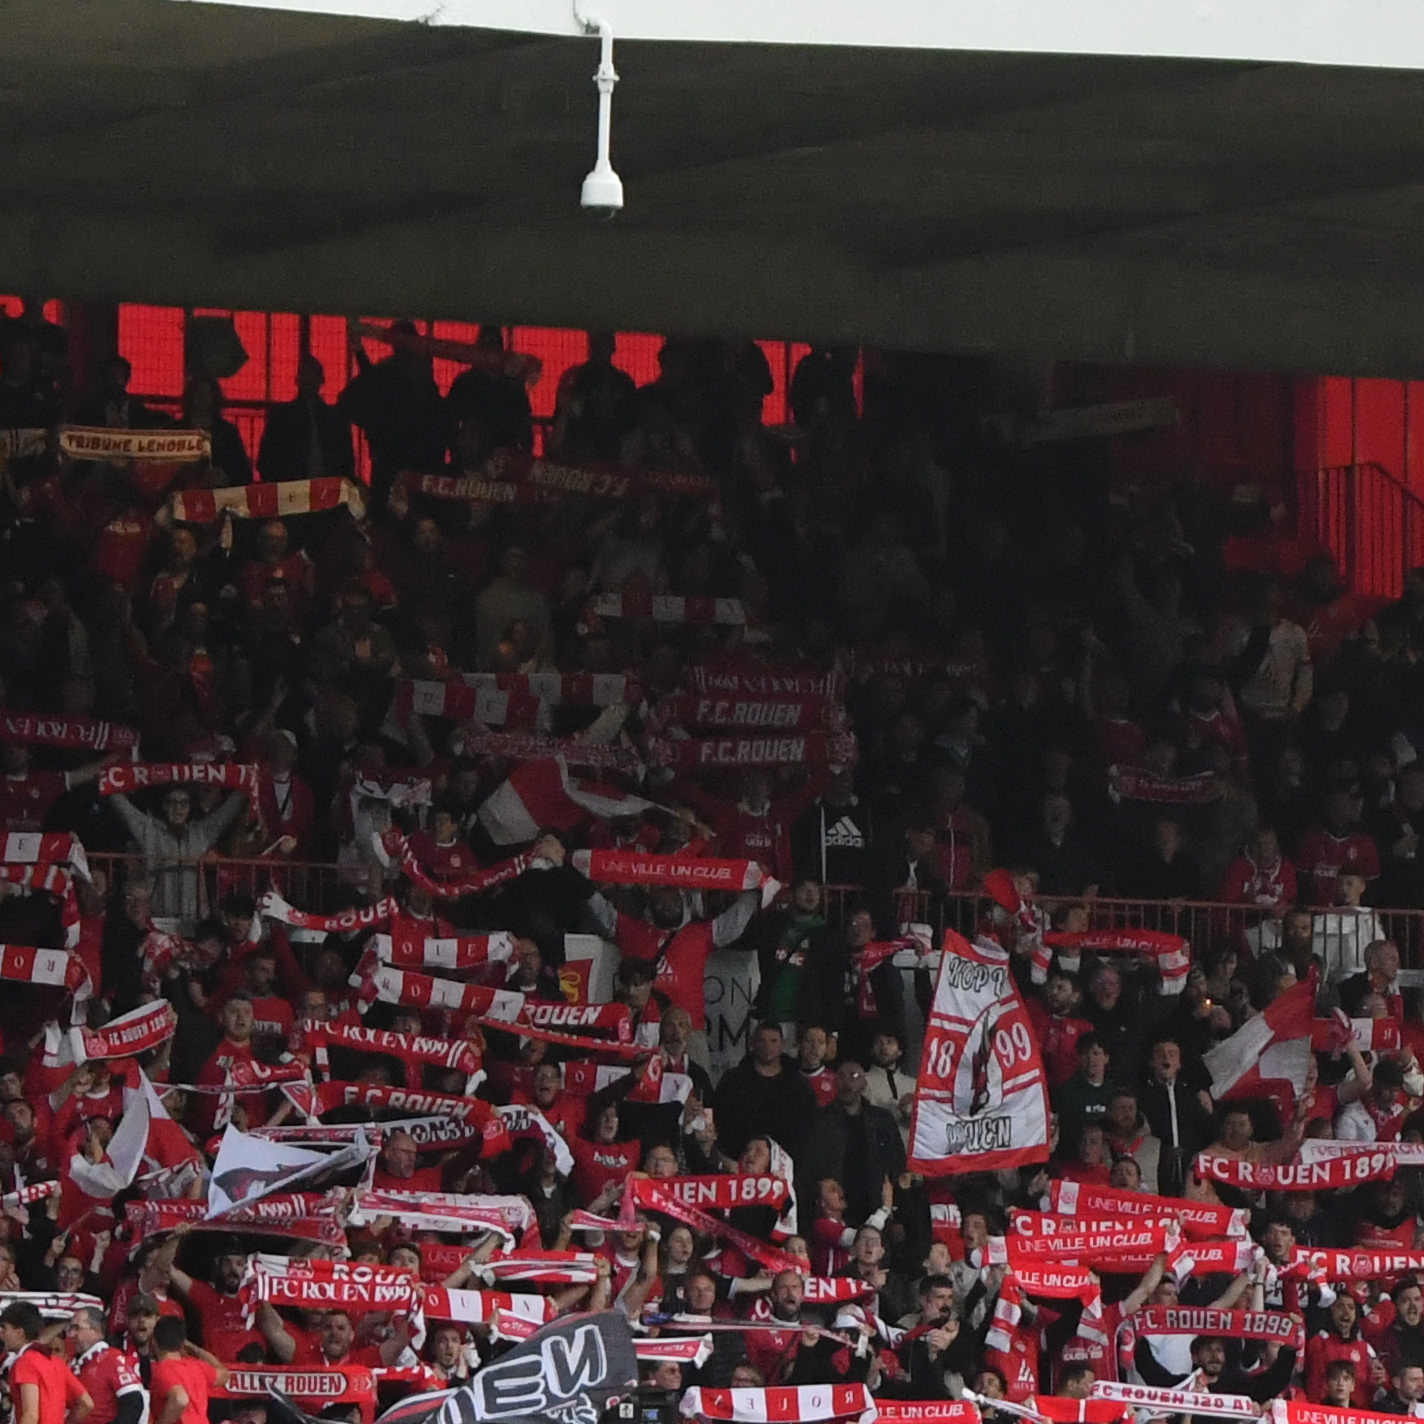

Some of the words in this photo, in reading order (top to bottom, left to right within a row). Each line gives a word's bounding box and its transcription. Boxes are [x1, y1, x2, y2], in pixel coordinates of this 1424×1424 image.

[66, 437, 132, 453] TRIBUNE
[138, 437, 205, 452] LENOBLE
[697, 702, 801, 727] F.C.ROUEN
[700, 738, 805, 762] F.C.ROUEN
[825, 833, 864, 848] adidas
[629, 862, 666, 876] VILLE
[671, 864, 691, 878] UN
[927, 1038, 955, 1077] 18
[996, 1022, 1032, 1068] 99
[1198, 1154, 1231, 1179] FC
[727, 1179, 784, 1202] 1899
[1046, 1236, 1084, 1252] VILLE
[1089, 1235, 1110, 1249] UN
[272, 1277, 298, 1298] FC
[300, 1278, 371, 1301] ROUEN
[374, 1282, 412, 1302] 1899
[1166, 1310, 1233, 1331] ROUEN
[1242, 1313, 1294, 1335] 1899
[284, 1373, 343, 1394] ROUEN
[1090, 1385, 1112, 1399] FC
[1121, 1386, 1185, 1405] ROUEN
[1191, 1393, 1227, 1409] 120
[900, 1405, 921, 1419] UN
